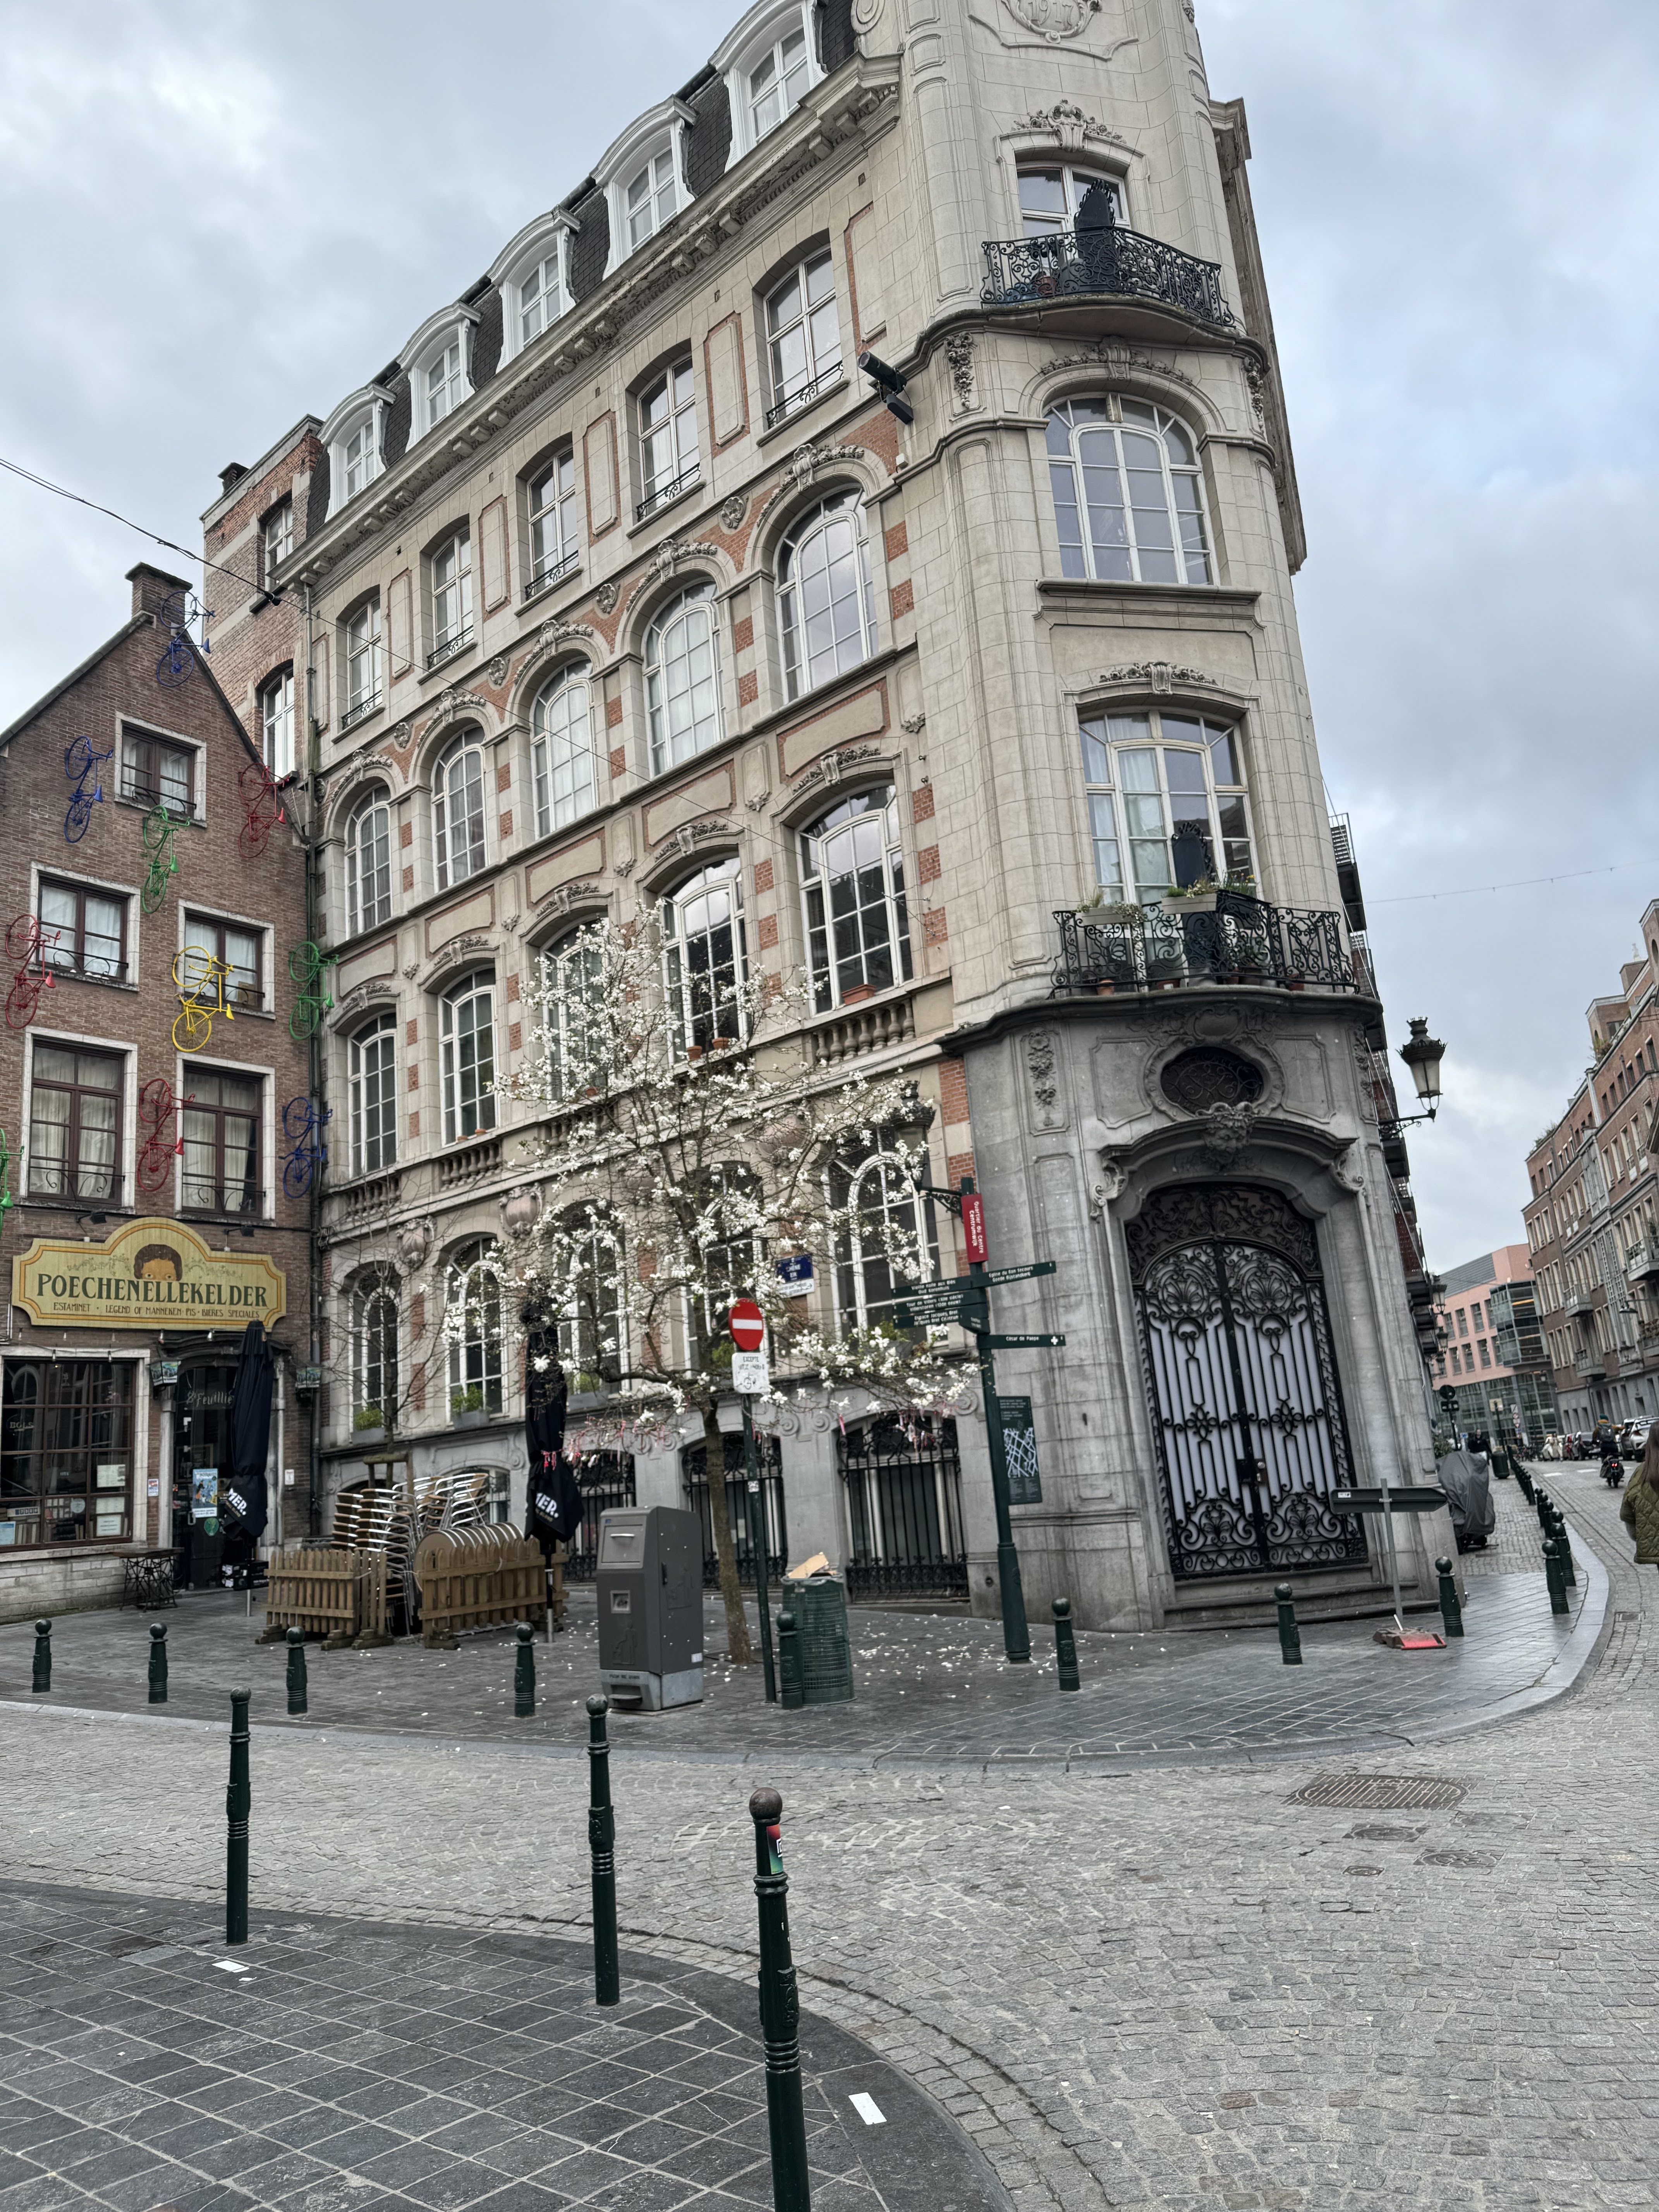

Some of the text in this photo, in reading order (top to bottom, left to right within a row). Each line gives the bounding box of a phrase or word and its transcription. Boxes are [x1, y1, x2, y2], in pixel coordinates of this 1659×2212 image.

[1028, 0, 1073, 26] 1917
[969, 1210, 978, 1247] Centrumwijk
[37, 1274, 267, 1307] POECHENELLEKELDER
[53, 1302, 90, 1312] ESTAMINET
[106, 1305, 130, 1314] LEGEND
[134, 1306, 142, 1314] OF
[146, 1307, 182, 1316] MANNEKEN
[186, 1308, 196, 1316] PIS
[228, 1310, 260, 1318] SPECIALES
